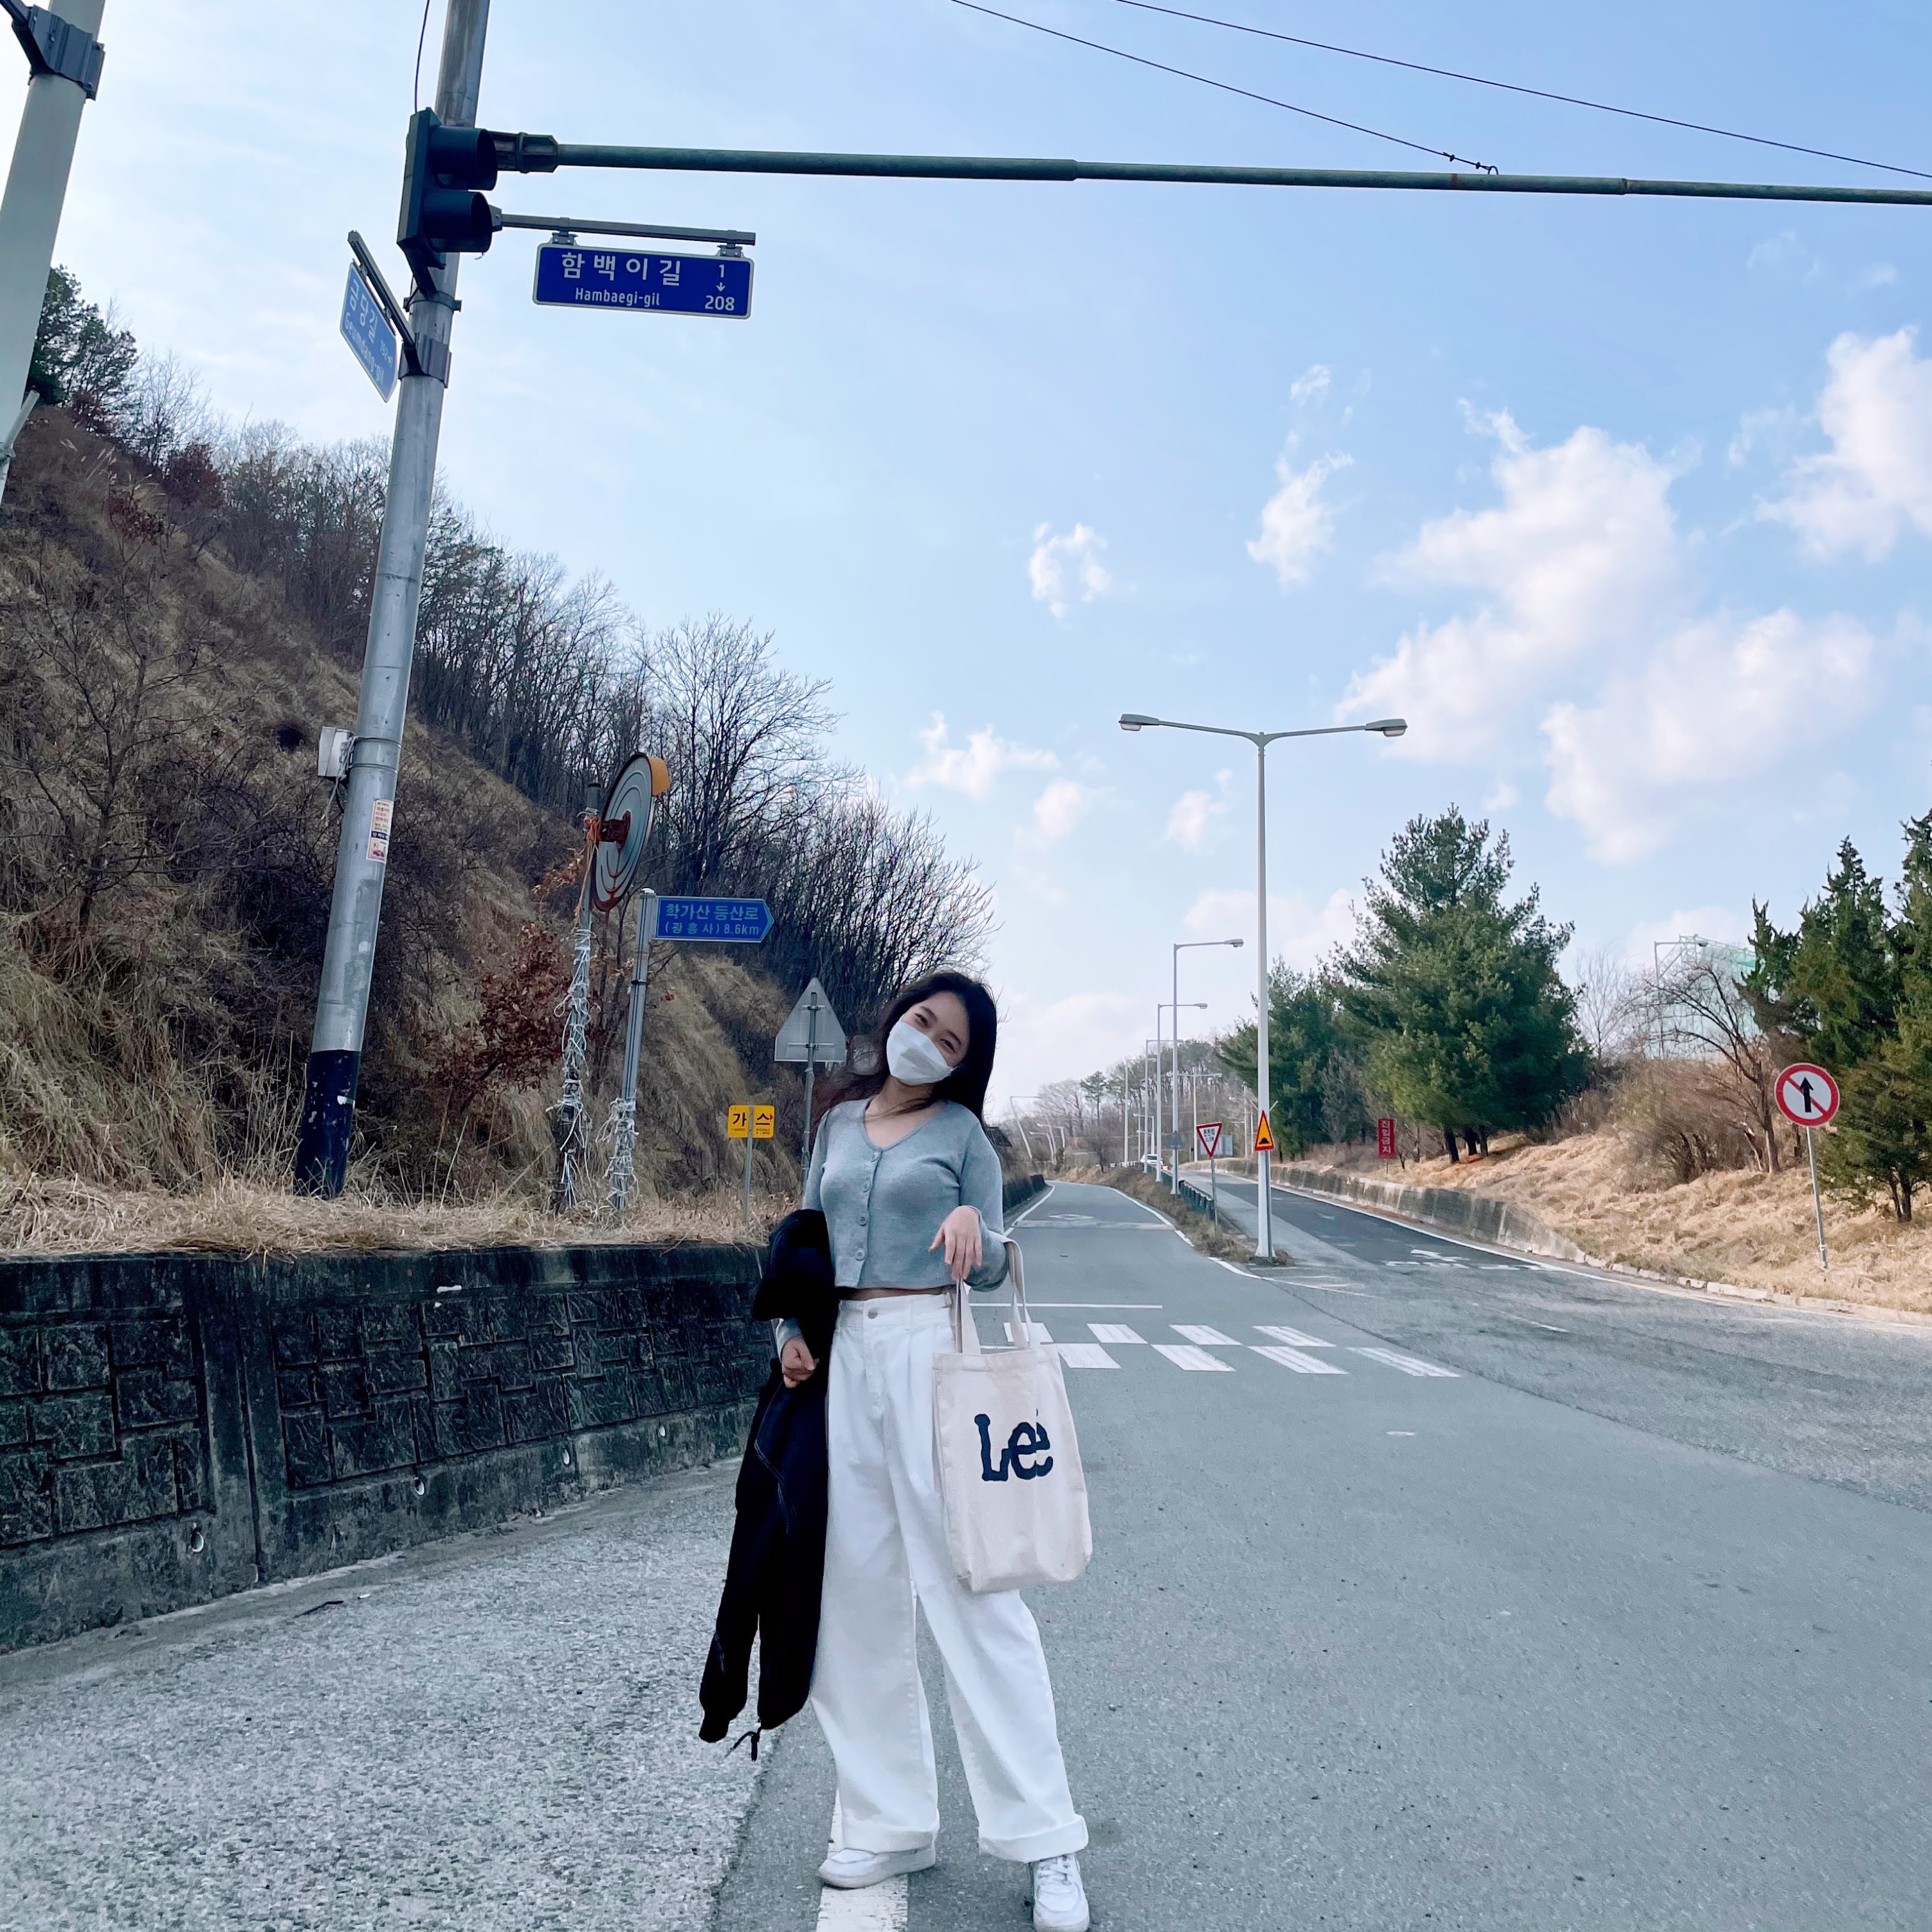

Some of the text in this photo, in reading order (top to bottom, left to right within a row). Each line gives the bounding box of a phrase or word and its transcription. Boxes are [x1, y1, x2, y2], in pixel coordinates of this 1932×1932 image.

[562, 252, 681, 286] 함백이길
[719, 264, 725, 278] 1
[575, 288, 660, 307] Hambaegi-gil
[704, 295, 735, 311] 208
[350, 278, 378, 344] 금당길
[345, 312, 384, 383] Geumdang-gil
[666, 903, 759, 921] 학가산 등산로
[723, 924, 760, 935] 8.6km
